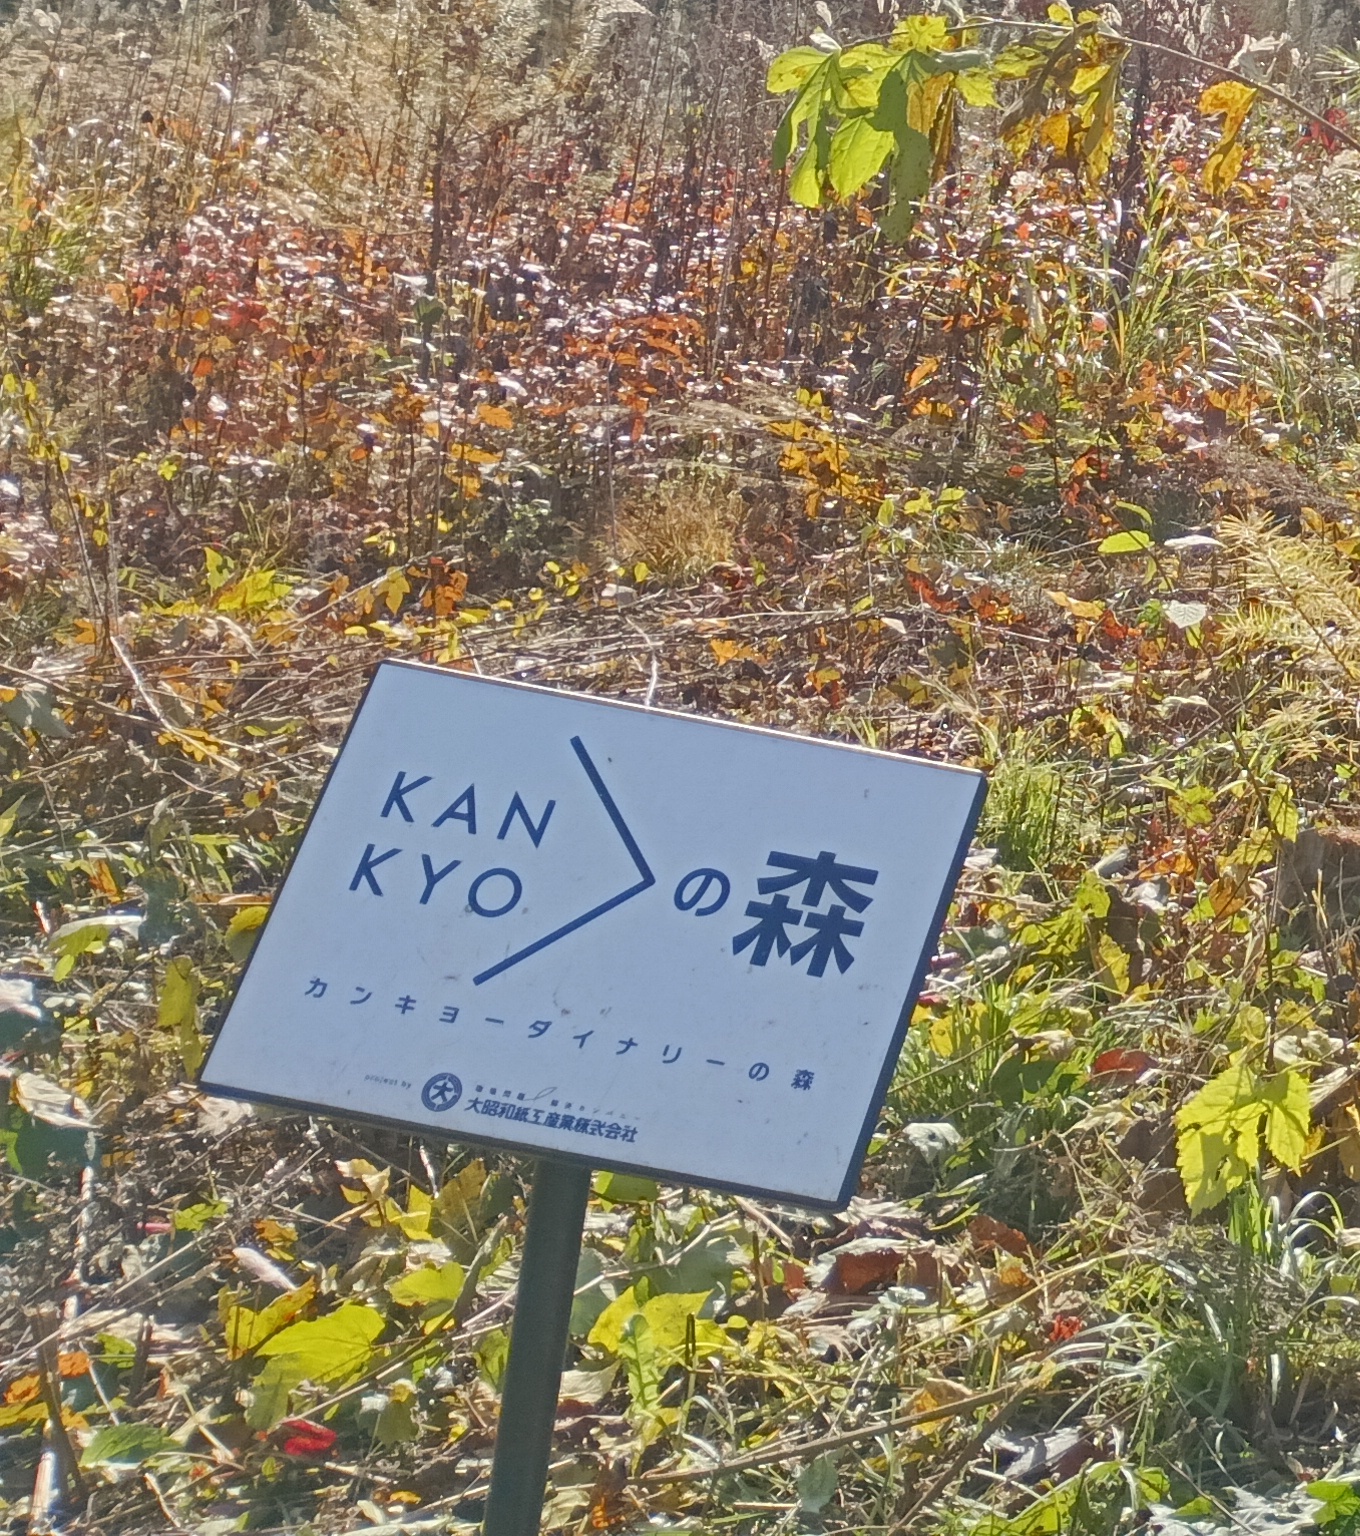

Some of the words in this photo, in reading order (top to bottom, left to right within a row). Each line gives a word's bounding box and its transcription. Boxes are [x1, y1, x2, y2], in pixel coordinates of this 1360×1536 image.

[380, 771, 557, 850] KAN
[349, 842, 523, 919] KYO
[674, 850, 880, 979] の森
[304, 977, 815, 1093] カンキョーダイナリーの森
[464, 1096, 639, 1144] 大昭和紙工産業株式会社
